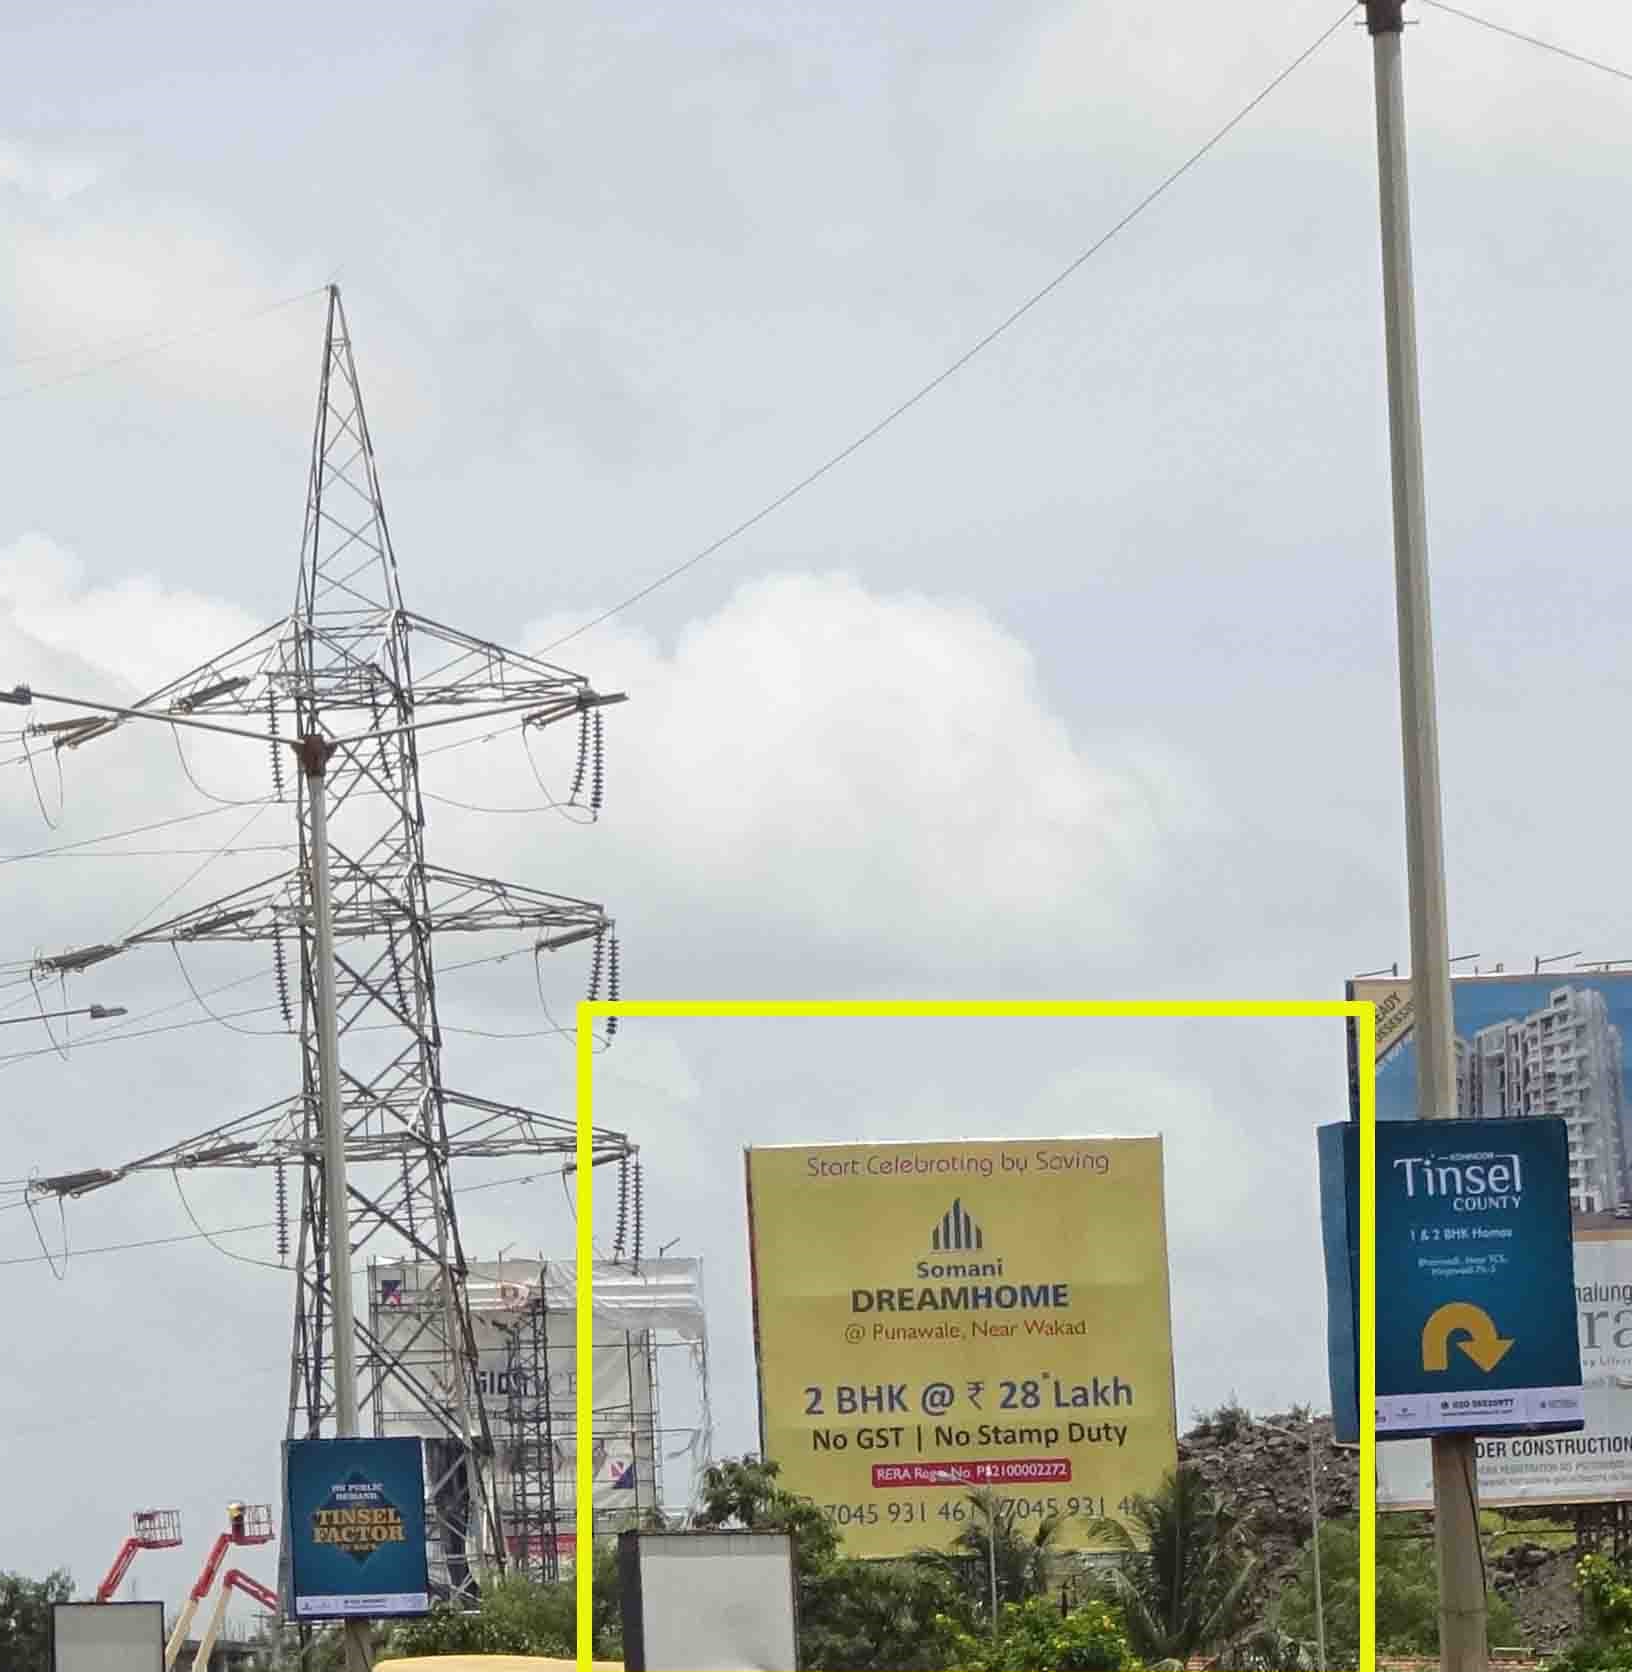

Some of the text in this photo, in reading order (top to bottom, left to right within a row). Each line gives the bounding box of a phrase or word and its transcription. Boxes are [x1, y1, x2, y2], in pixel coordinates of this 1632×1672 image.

[807, 1150, 1111, 1177] Start Celebrating by Saving
[1392, 1153, 1523, 1198] Tinsel
[1452, 1195, 1522, 1212] COUNTY
[916, 1258, 1004, 1280] Somani
[851, 1283, 1070, 1314] DREAMHOME
[843, 1318, 1088, 1345] @ Punawale, Near Wakad
[802, 1385, 826, 1416] 2
[835, 1382, 911, 1415] BHK
[920, 1381, 957, 1417] @
[1053, 1375, 1134, 1410] Lakh
[812, 1428, 849, 1452] No
[856, 1426, 905, 1450] GST
[934, 1425, 970, 1448] No
[977, 1423, 1060, 1450] Stamp
[1067, 1421, 1129, 1447] Duty
[1475, 1440, 1507, 1459] DER
[876, 1467, 912, 1481] RERA
[316, 1507, 401, 1526] TINSEL
[887, 1501, 927, 1524] 931
[1066, 1495, 1105, 1519] 931
[312, 1525, 406, 1543] FACTOR
